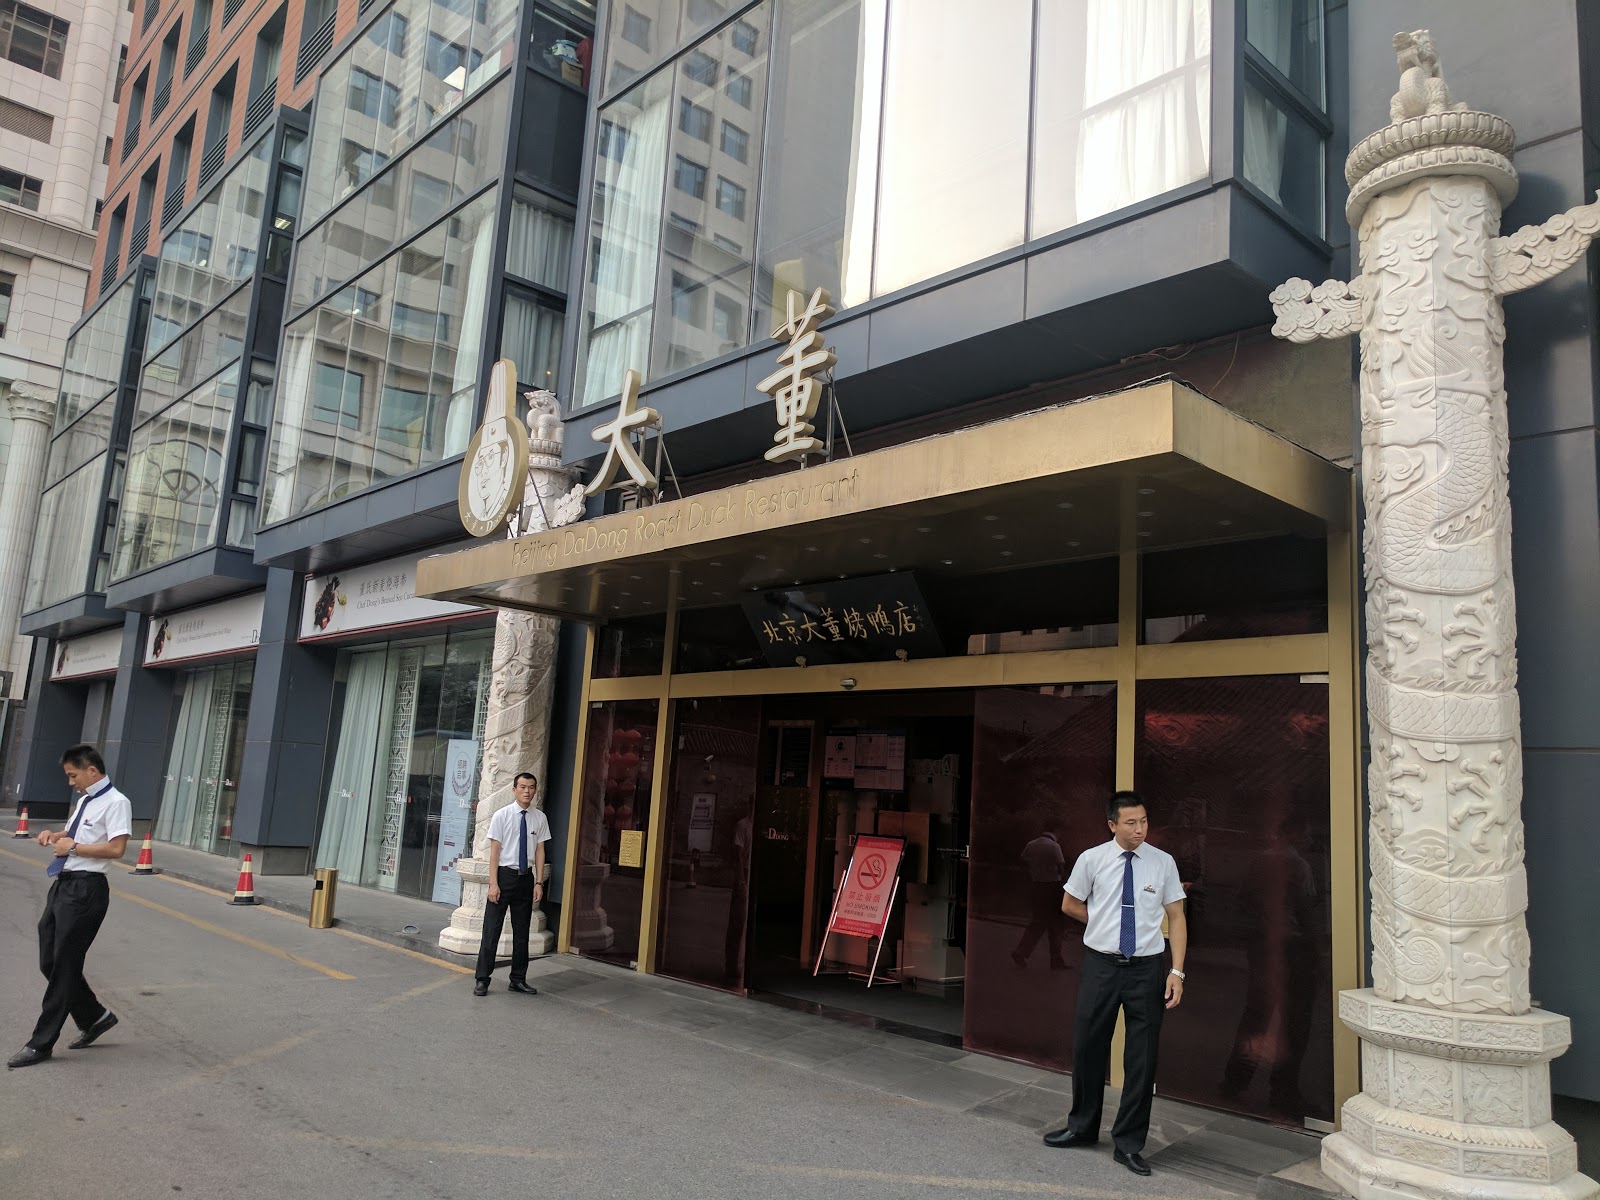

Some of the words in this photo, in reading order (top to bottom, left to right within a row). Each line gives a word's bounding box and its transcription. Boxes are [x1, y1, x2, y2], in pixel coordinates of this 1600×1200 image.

[511, 541, 558, 570] Beijing
[563, 526, 629, 553] DaDong
[635, 509, 682, 541] Roast
[687, 492, 736, 531] Duck
[744, 468, 860, 518] Restaurant
[854, 902, 879, 912] SMOKING
